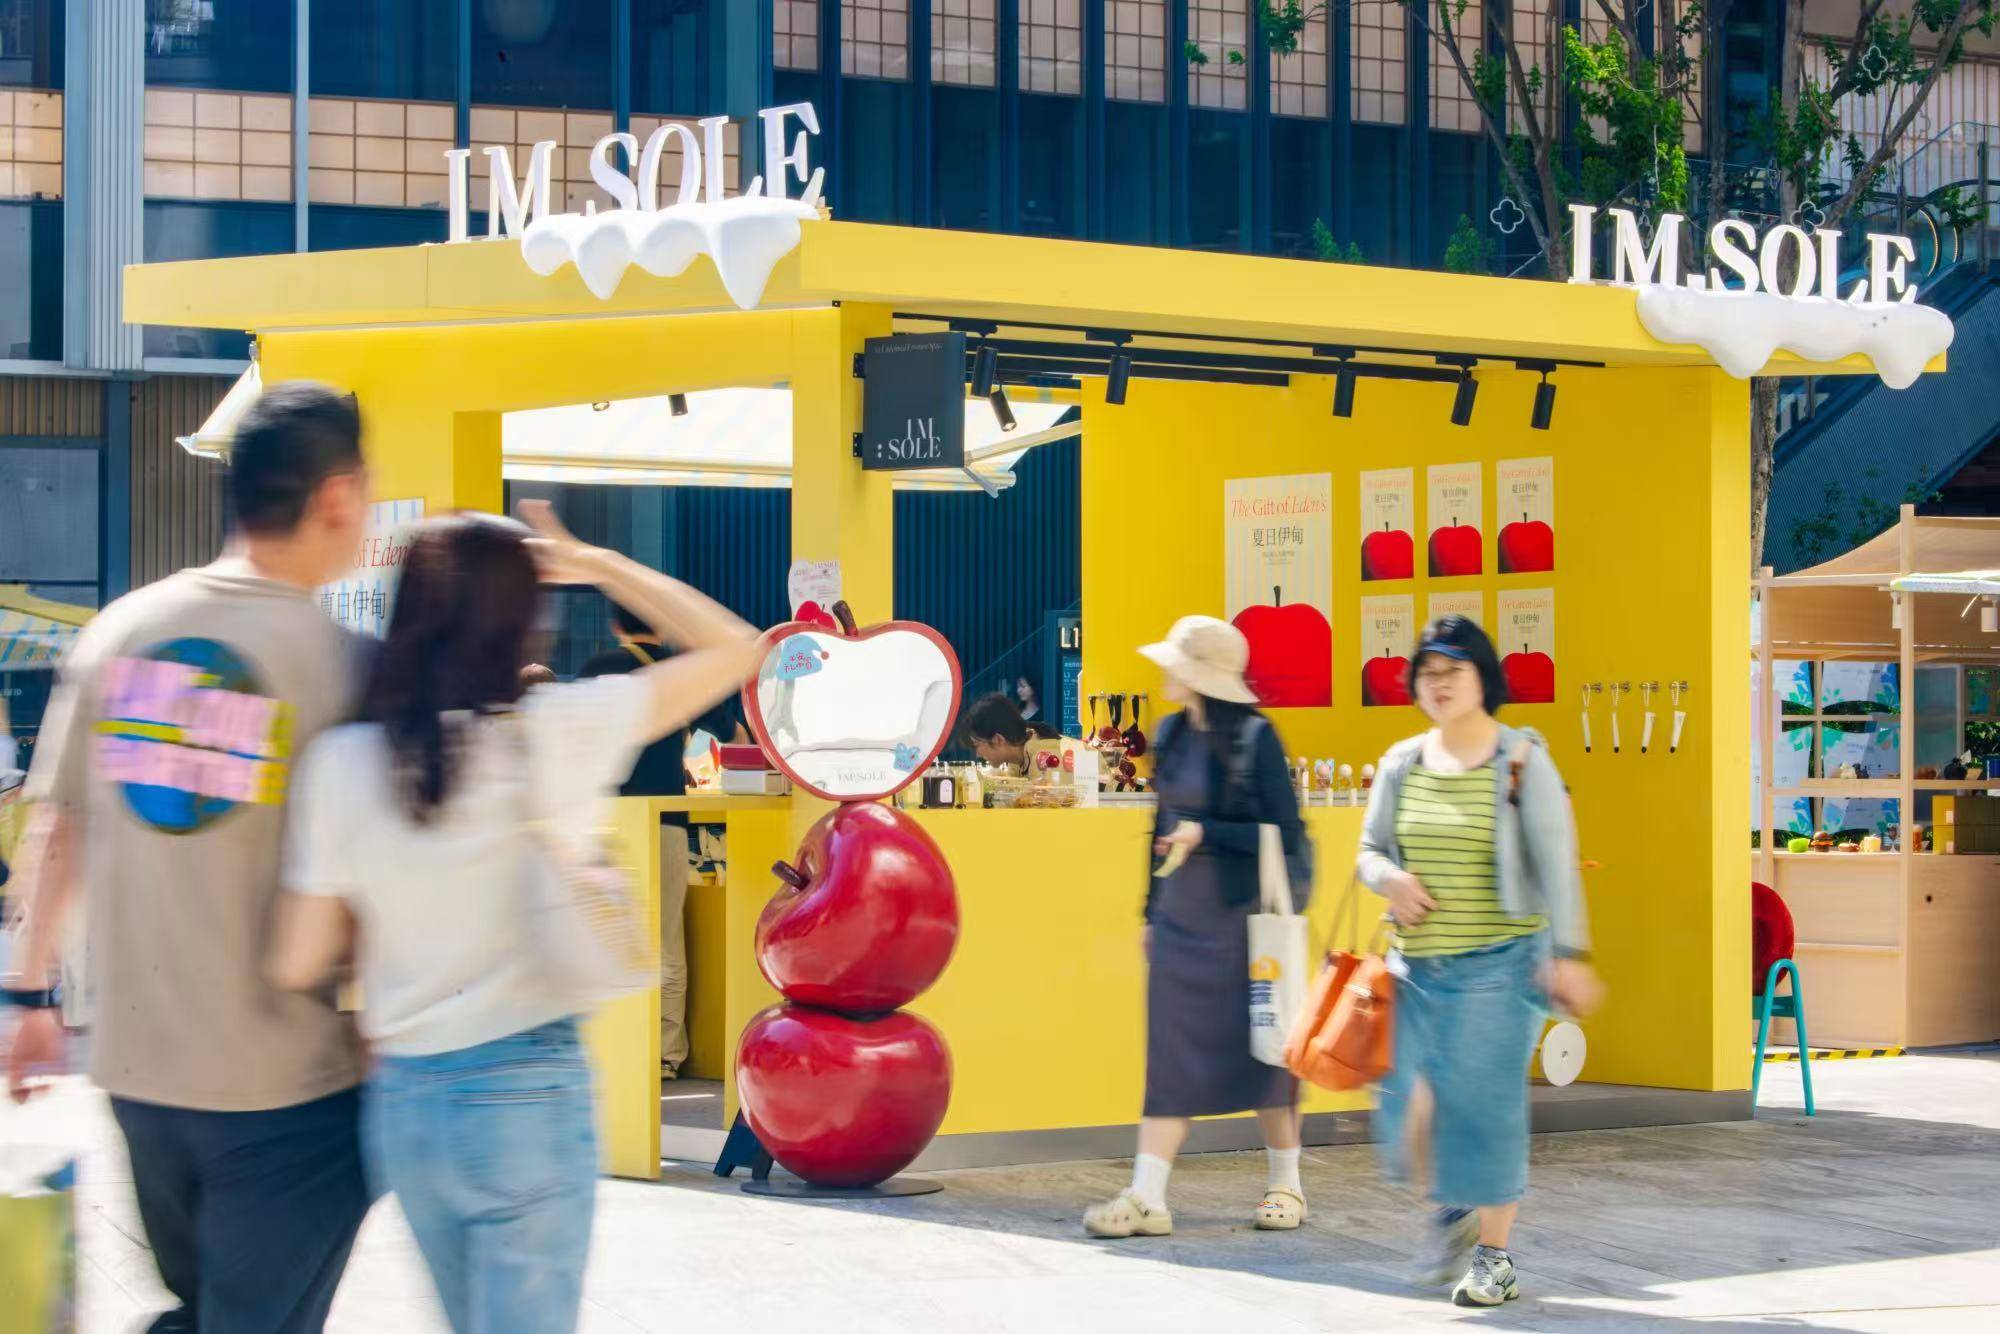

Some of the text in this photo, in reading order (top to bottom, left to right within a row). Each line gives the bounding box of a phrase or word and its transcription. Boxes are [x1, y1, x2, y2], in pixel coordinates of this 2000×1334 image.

[1231, 496, 1248, 518] The
[1252, 497, 1276, 516] Gift
[1277, 495, 1291, 515] of
[1252, 525, 1304, 547] 夏日伊甸
[1061, 626, 1079, 648] L1
